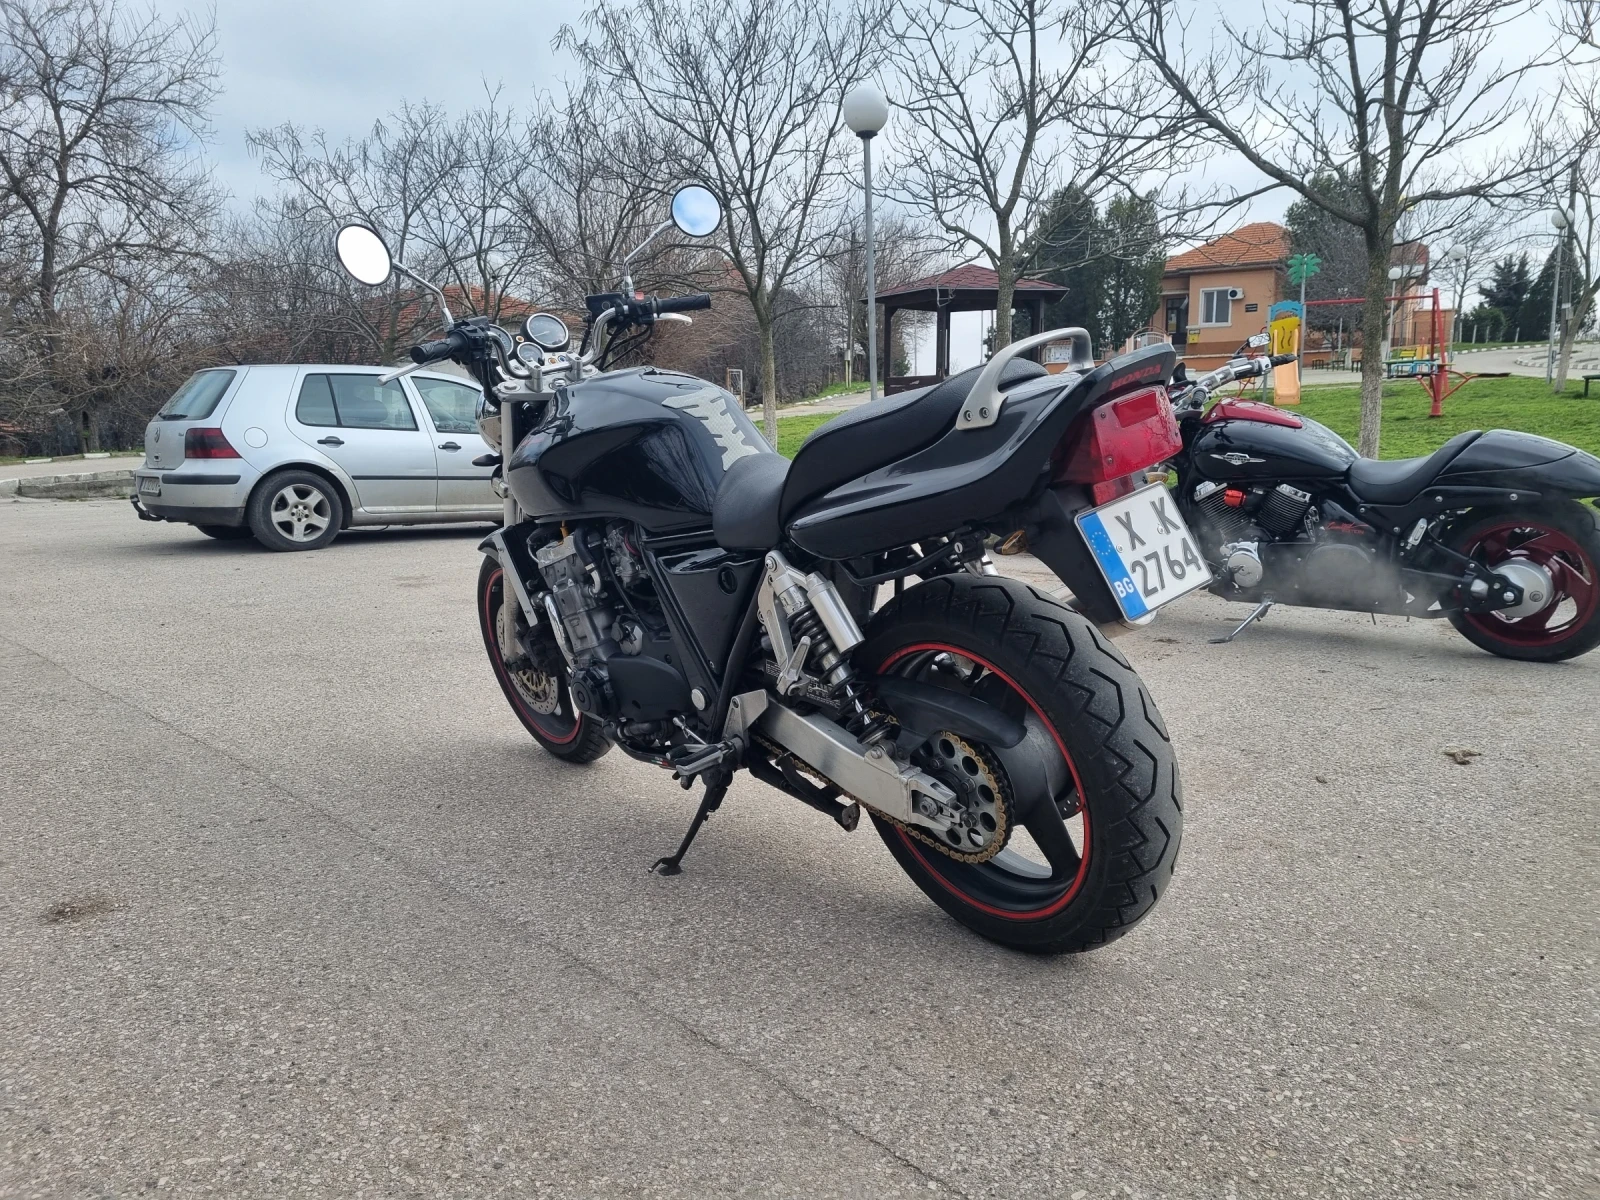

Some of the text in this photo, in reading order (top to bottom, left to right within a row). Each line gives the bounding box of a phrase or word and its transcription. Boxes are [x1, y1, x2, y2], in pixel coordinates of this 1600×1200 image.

[1109, 363, 1161, 391] HONDA
[1114, 496, 1181, 551] X K
[1113, 577, 1135, 599] BG
[1130, 537, 1202, 599] 2764
